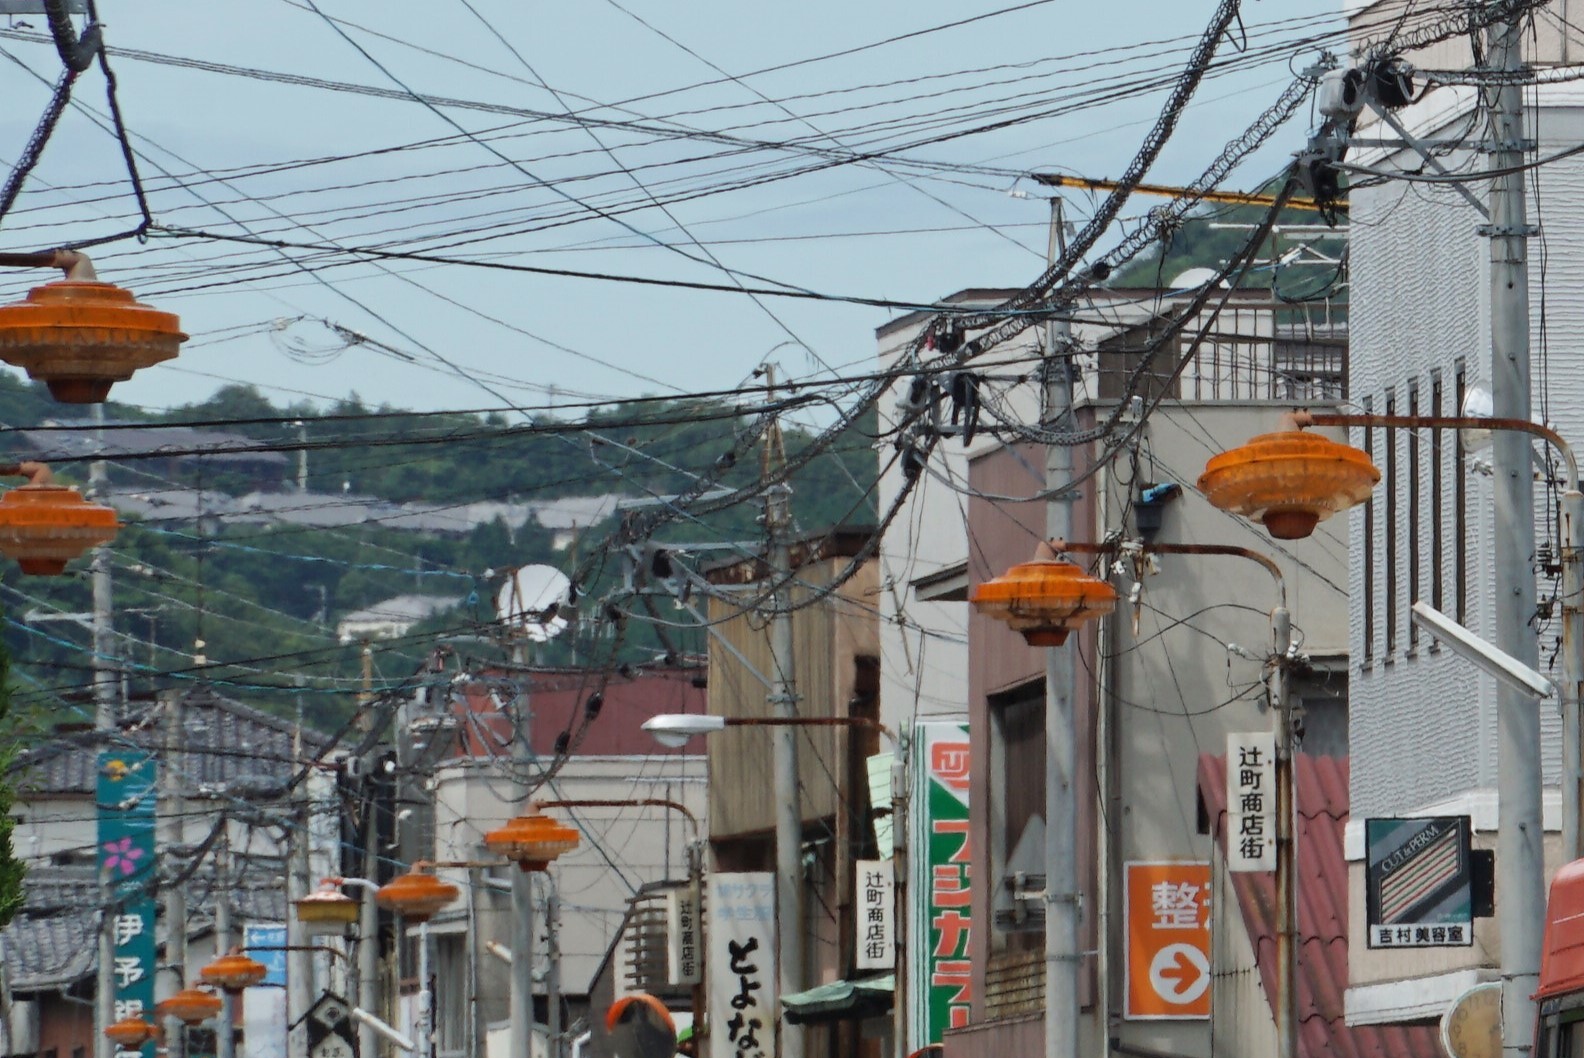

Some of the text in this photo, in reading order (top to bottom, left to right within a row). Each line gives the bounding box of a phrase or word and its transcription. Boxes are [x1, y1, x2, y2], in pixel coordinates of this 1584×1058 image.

[1239, 746, 1265, 860] 辻町商店街
[865, 871, 885, 960] 辻町商店街
[1379, 925, 1464, 943] 吉村美容室
